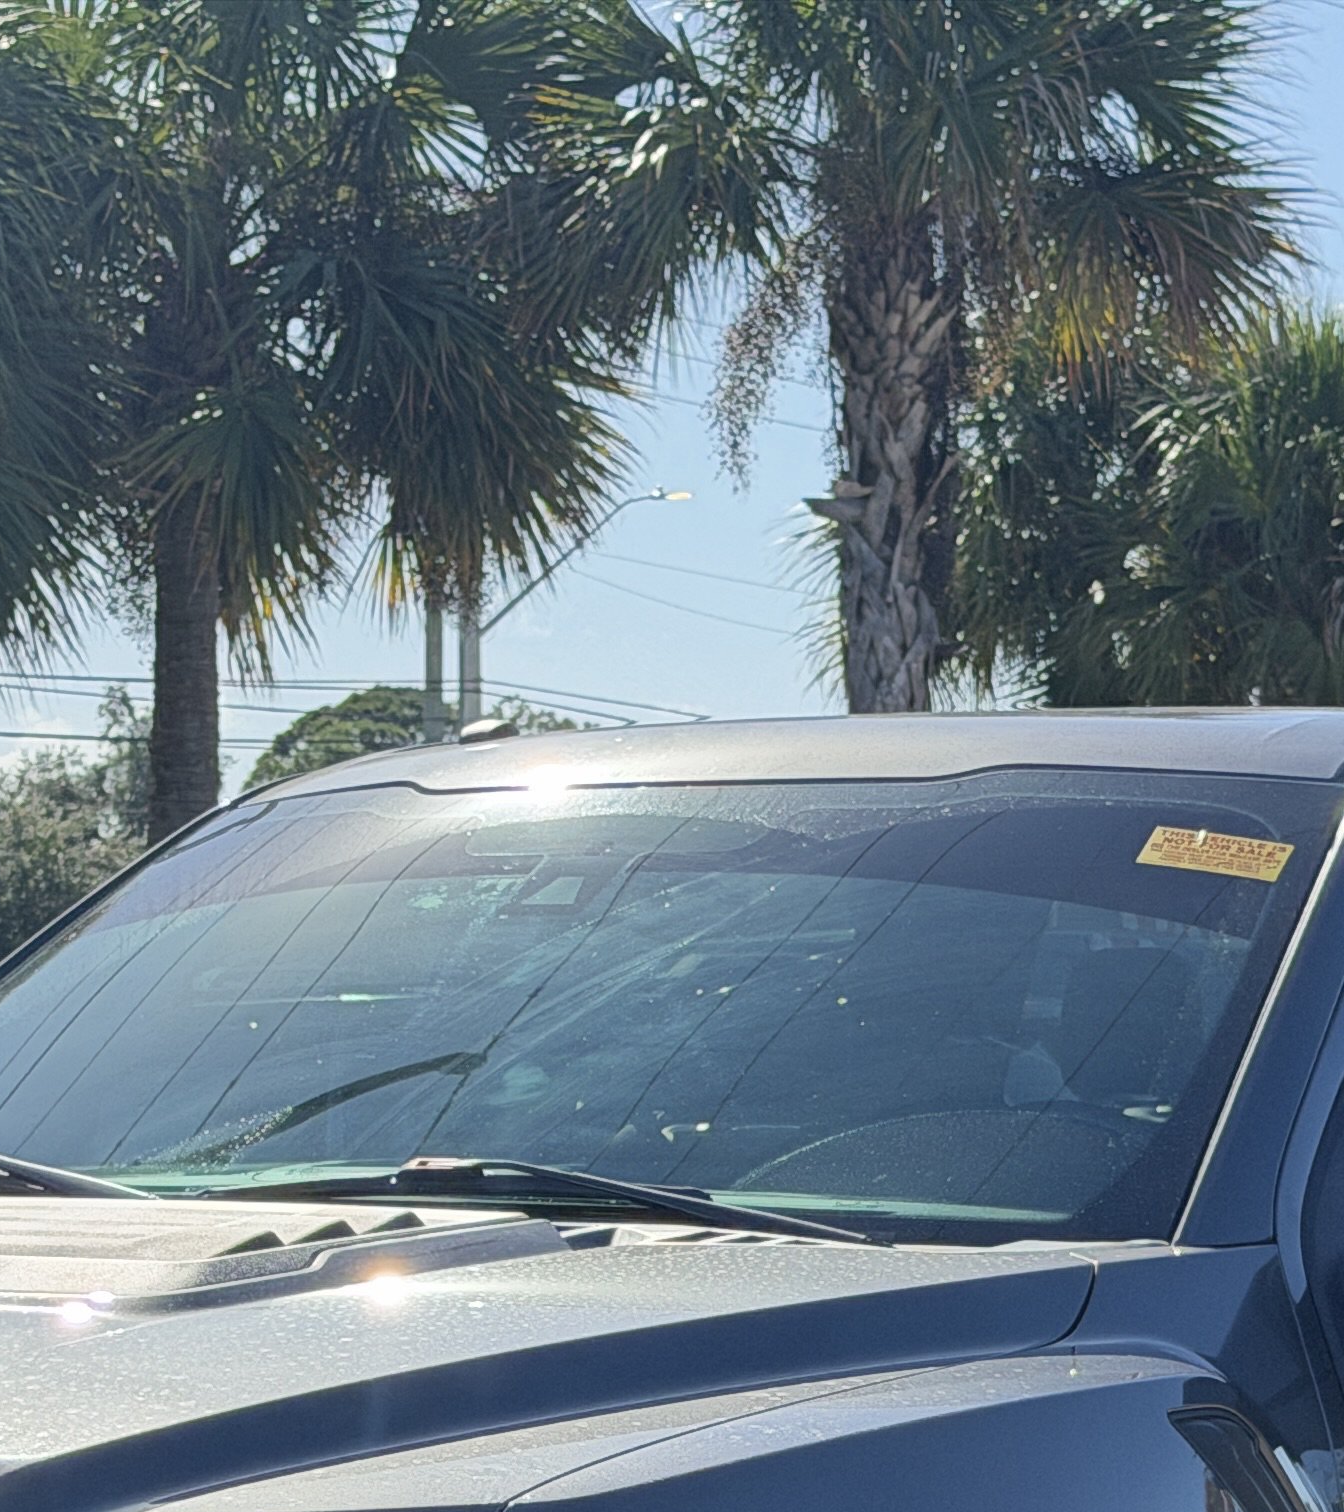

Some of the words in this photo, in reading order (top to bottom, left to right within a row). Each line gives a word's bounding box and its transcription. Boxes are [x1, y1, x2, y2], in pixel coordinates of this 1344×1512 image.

[1161, 829, 1196, 838] THIS
[1271, 844, 1288, 852] IS
[1162, 836, 1197, 846] NOT
[1234, 846, 1278, 858] SALE
